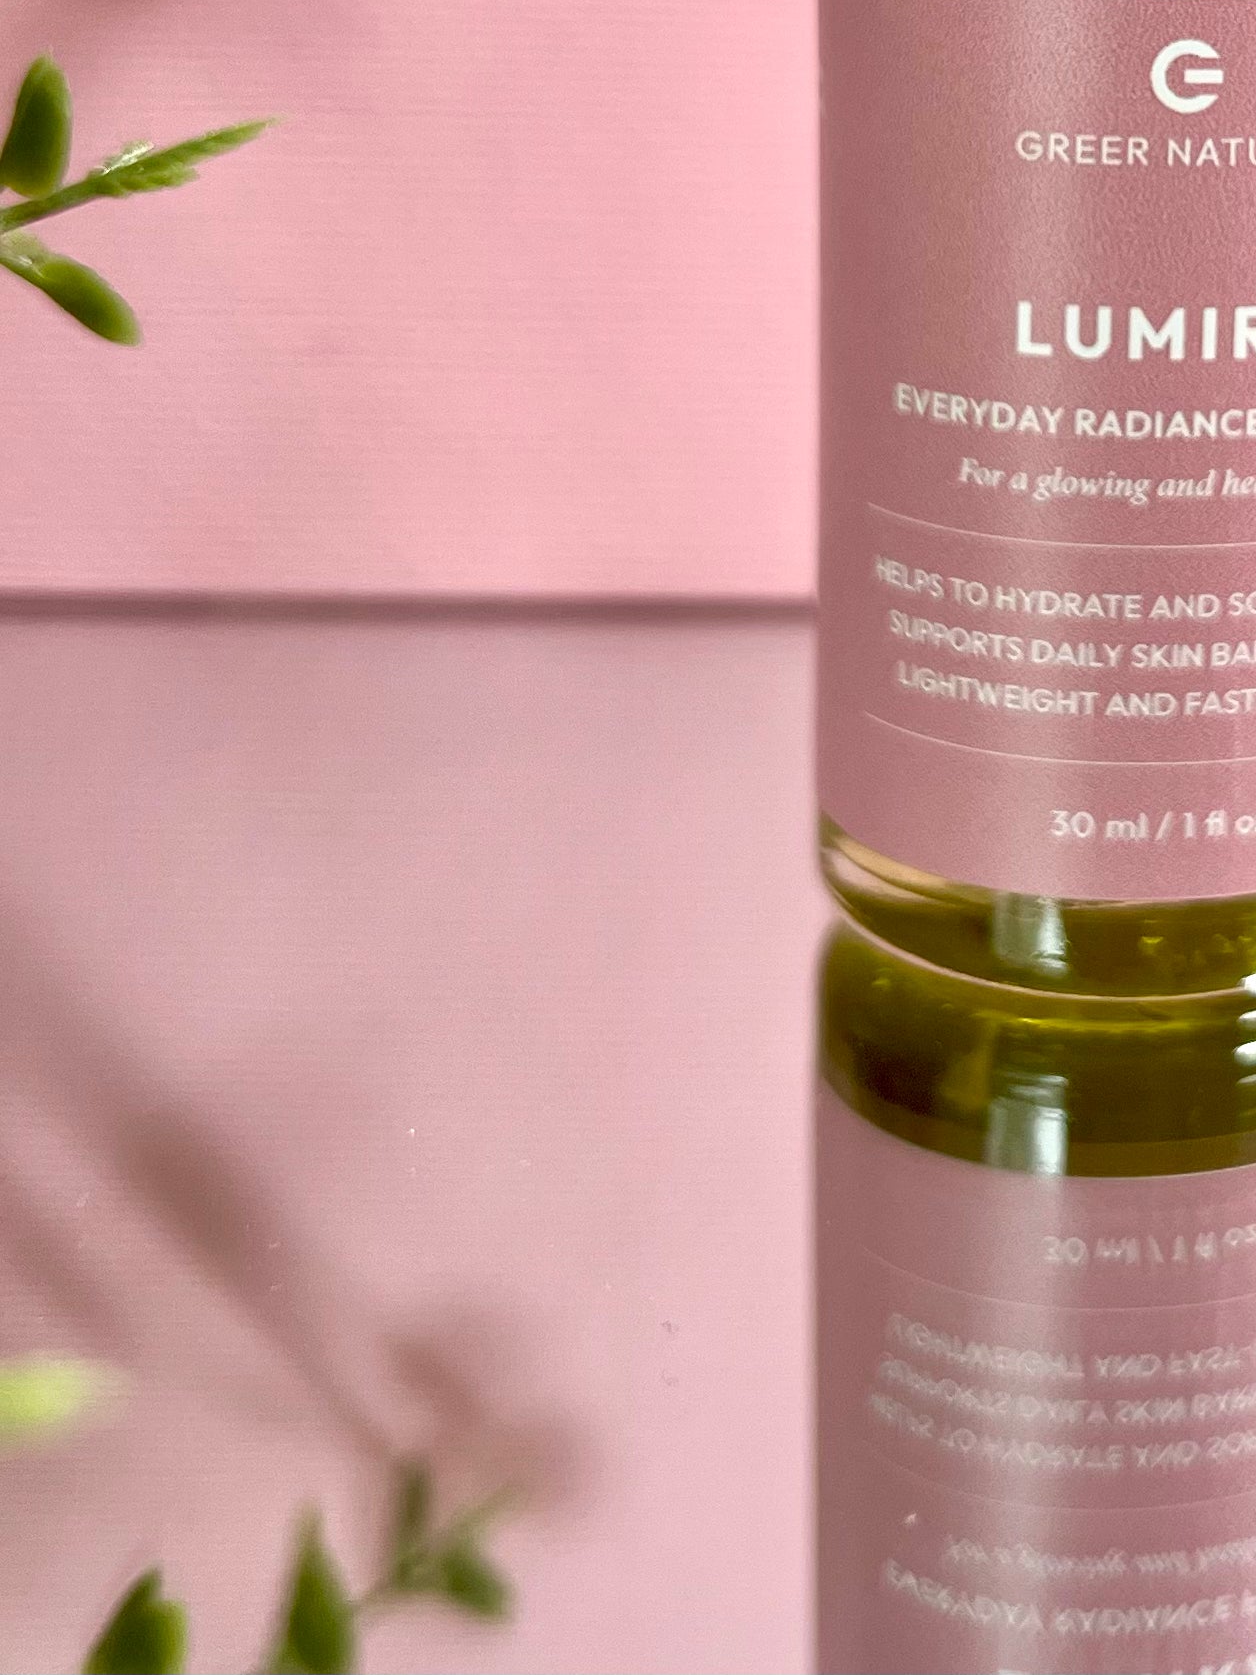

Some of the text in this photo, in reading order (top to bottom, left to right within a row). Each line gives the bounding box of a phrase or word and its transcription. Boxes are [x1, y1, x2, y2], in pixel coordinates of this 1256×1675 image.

[1014, 130, 1149, 166] GREER
[894, 382, 1064, 434] EVERYDAY
[958, 456, 1006, 487] For
[1010, 472, 1028, 491] a
[1031, 465, 1151, 506] glowing
[1157, 469, 1216, 497] and
[873, 555, 945, 600] HELPS
[949, 577, 990, 607] TO
[994, 585, 1143, 619] HYDRATE
[1149, 592, 1221, 620] AND
[889, 609, 1025, 662] SUPPORTS
[1029, 639, 1125, 668] DAILY
[1130, 642, 1204, 669] SKIN
[894, 660, 1100, 716] LIGHTWEIGHT
[1104, 692, 1177, 718] AND
[1050, 810, 1096, 838] 30
[1104, 812, 1149, 839] ml
[1154, 810, 1173, 841] /
[1183, 812, 1196, 838] 1
[1204, 810, 1228, 837] fl
